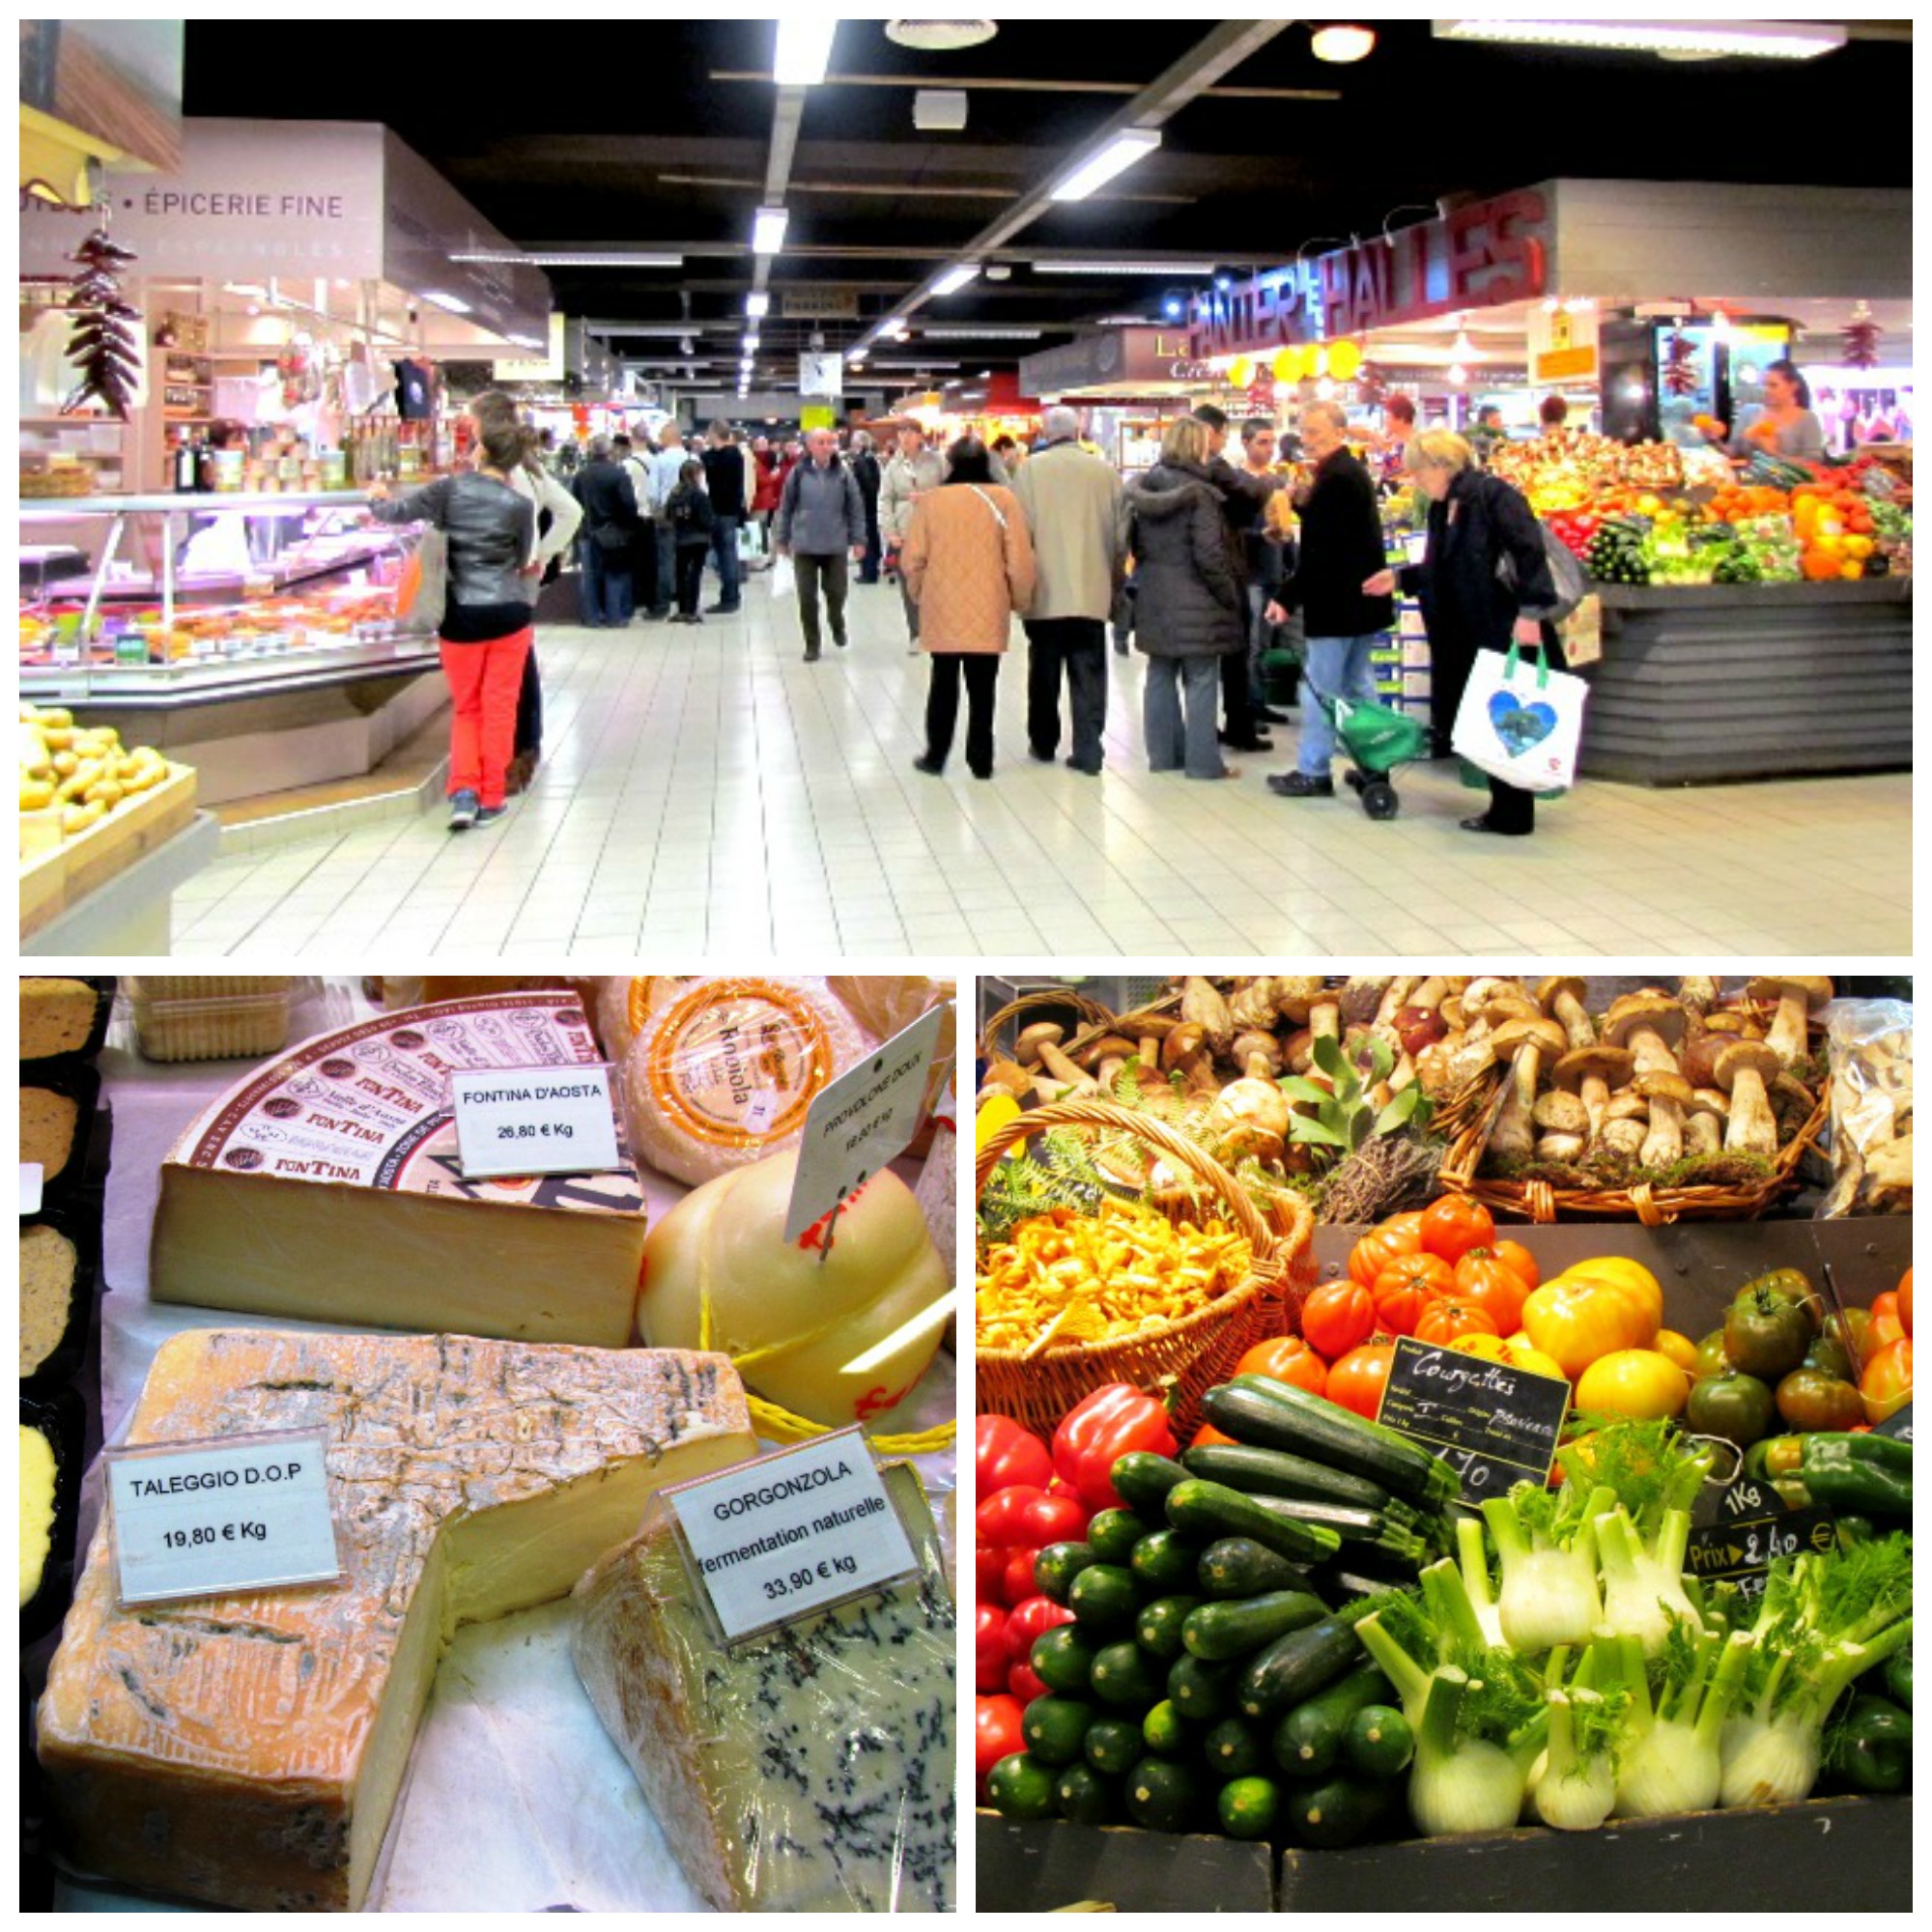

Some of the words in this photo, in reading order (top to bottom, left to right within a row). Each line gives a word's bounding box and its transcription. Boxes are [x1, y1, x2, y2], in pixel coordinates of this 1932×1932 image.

[145, 186, 271, 214] ÉPICERIE
[281, 196, 343, 218] FINE
[1321, 193, 1546, 338] HALLES
[355, 1076, 424, 1114] FONTINA
[463, 1089, 531, 1105] FONTINA
[535, 1085, 602, 1100] D'AOSTA
[305, 1113, 385, 1145] FONTINA
[497, 1125, 535, 1140] 26,80
[540, 1123, 551, 1136] €
[554, 1122, 573, 1138] Kg
[274, 1158, 360, 1179] FONTINA
[1412, 1350, 1518, 1397] Courgettes
[130, 1469, 239, 1496] TALEGGIO
[245, 1463, 301, 1485] D.O.P
[713, 1461, 852, 1520] GORGONZOLA
[163, 1526, 215, 1548] 19,80
[222, 1523, 235, 1540] €
[241, 1521, 267, 1540] Kg
[697, 1524, 809, 1575] fermentation
[813, 1496, 886, 1534] naturelle
[1690, 1546, 1729, 1571] Prix
[1810, 1521, 1833, 1553] €
[763, 1568, 813, 1600] 33,90
[817, 1561, 832, 1578] €
[833, 1554, 858, 1575] kg
